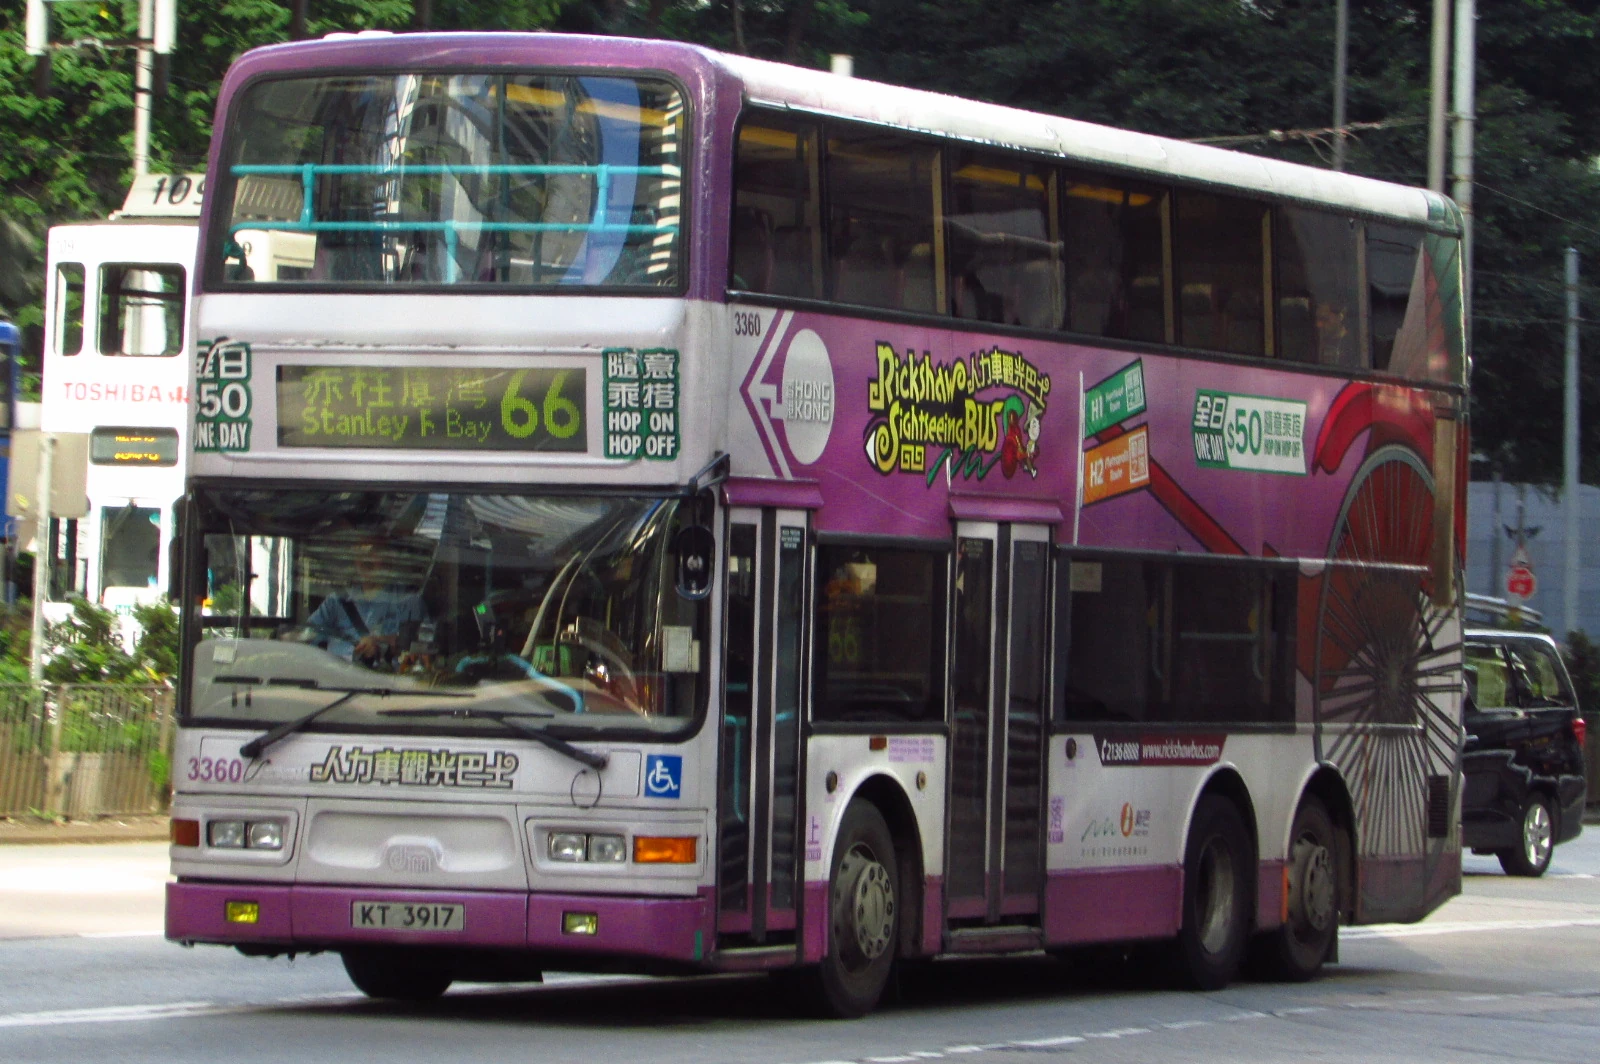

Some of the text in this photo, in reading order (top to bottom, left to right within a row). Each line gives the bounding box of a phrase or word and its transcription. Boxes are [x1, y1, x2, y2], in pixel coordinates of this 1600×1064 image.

[735, 311, 761, 337] 3360
[795, 379, 830, 401] HONG
[869, 344, 967, 411] Rickshaw
[64, 382, 162, 402] TOSHIBA
[501, 367, 580, 439] 66
[607, 382, 676, 409] 乘搭
[795, 400, 830, 421] KONG
[1090, 394, 1104, 423] H1
[1194, 395, 1227, 430] 全日
[220, 422, 248, 448] DAY
[302, 406, 407, 441] Stanley
[446, 408, 492, 442] Bay
[608, 411, 674, 433] HOP ON
[1227, 408, 1262, 456] $50
[609, 434, 675, 456] HOP OFF
[1089, 457, 1104, 488] H2
[187, 757, 243, 783] 3360
[310, 746, 519, 789] 人力車觀光巴士
[361, 904, 455, 927] KT 3917
